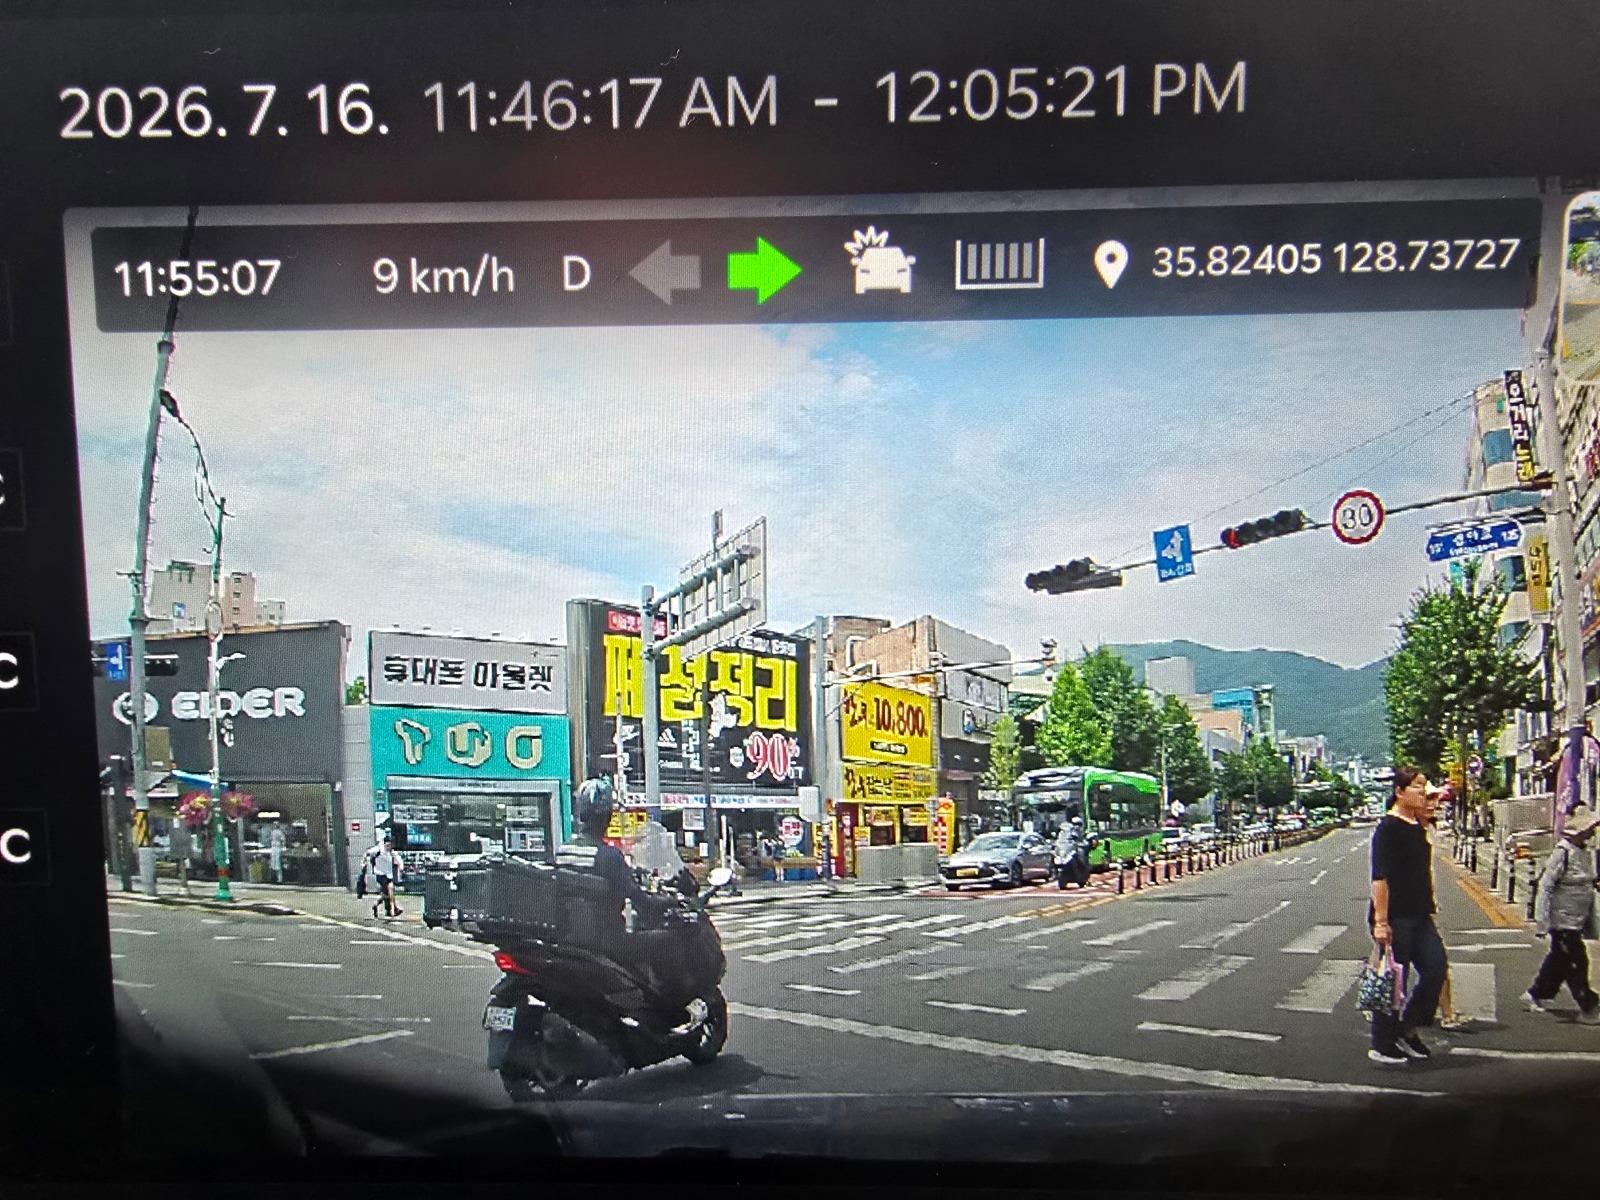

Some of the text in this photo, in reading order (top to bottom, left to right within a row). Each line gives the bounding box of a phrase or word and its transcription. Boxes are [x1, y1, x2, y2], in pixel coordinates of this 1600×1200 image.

[60, 85, 226, 138] 2026.
[243, 84, 288, 136] 7.
[308, 83, 388, 134] 16.
[425, 78, 662, 132] 11:46:17
[679, 75, 776, 127] AM
[877, 65, 1125, 122] 12:05:21
[1154, 61, 1245, 114] PM
[116, 239, 1520, 297] 11:55:07 9 km/h D 35.82405 128.73727
[1343, 503, 1373, 529] 30
[384, 655, 553, 692] 휴대폰 아울렛
